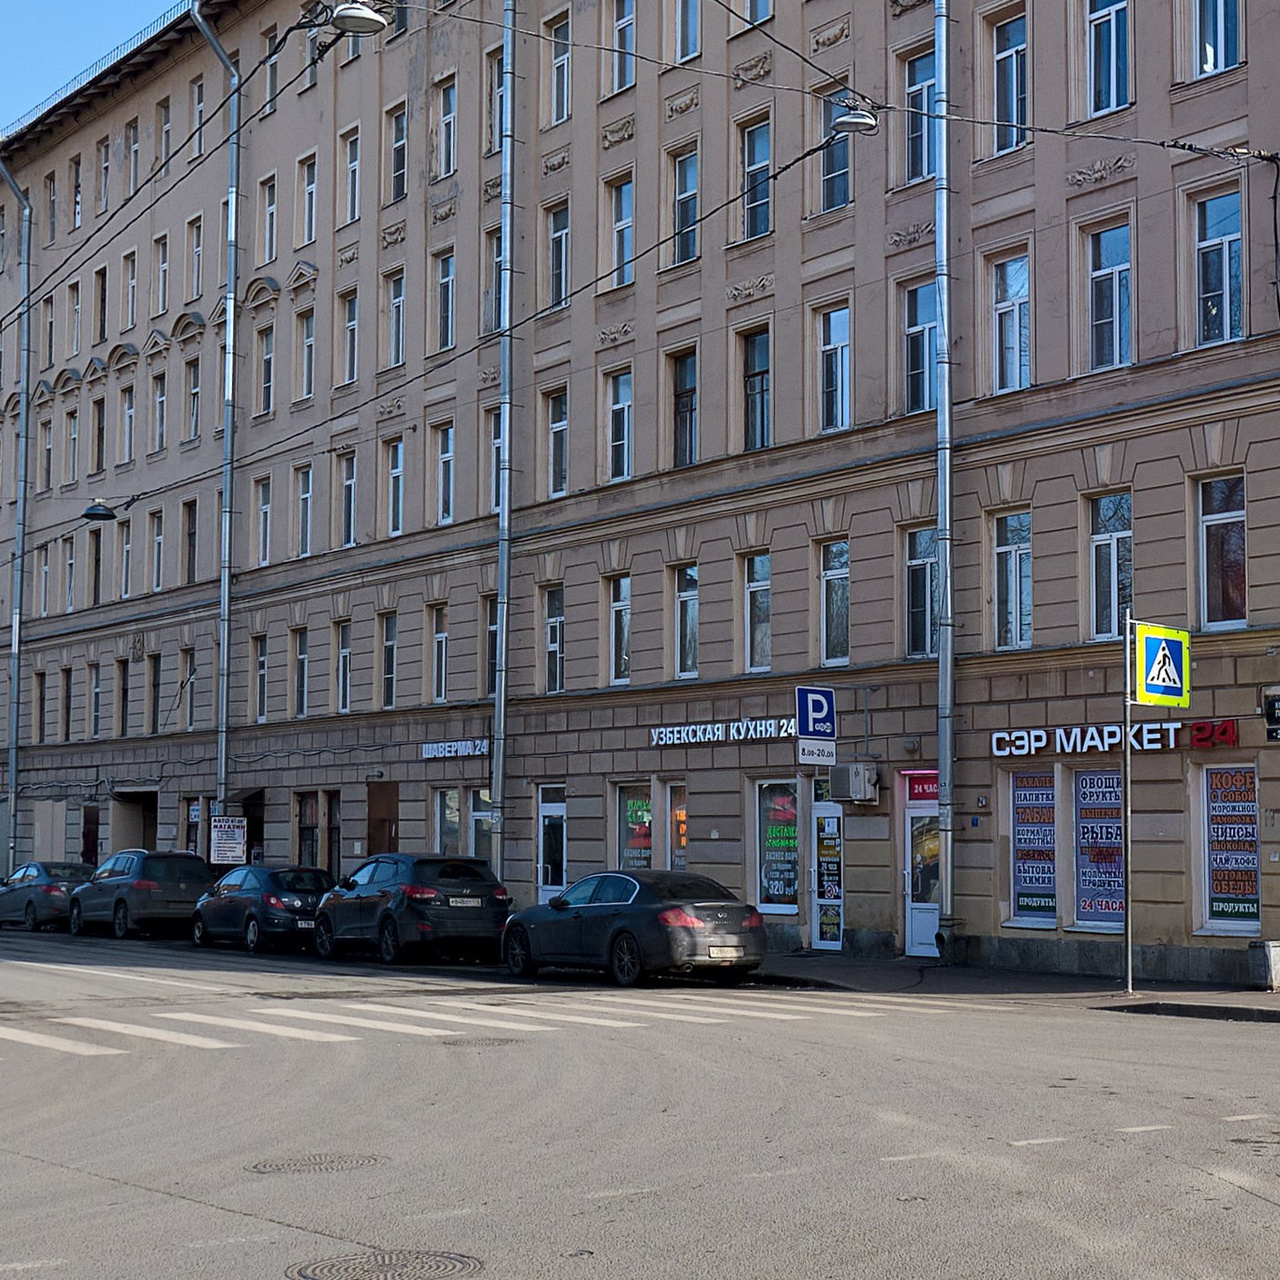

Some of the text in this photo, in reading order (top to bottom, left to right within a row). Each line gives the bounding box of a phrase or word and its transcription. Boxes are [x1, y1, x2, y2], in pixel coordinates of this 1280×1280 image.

[651, 718, 796, 745] УЗБЕКСКАЯ КУХНЯ 24
[992, 719, 1237, 756] СЭР МАРКЕТ 24
[422, 739, 488, 759] ШАВЕРМА 24
[801, 747, 834, 759] 8.00-20.00
[1211, 772, 1255, 790] КОФЕ
[914, 783, 939, 794] 24 ЧАС
[1221, 789, 1256, 803] СОБОЙ
[1211, 804, 1256, 814] МОРОЖЕНОЕ
[1211, 815, 1256, 825] ЗАМОРОЗКА
[1016, 828, 1040, 837] КОРМА
[1080, 824, 1123, 841] РЫБА
[1212, 825, 1256, 840] ЧИПСЫ
[1211, 840, 1257, 853] ШОКОЛАД
[1022, 875, 1052, 886] ХИМИЯ
[769, 881, 784, 895] 320
[1212, 880, 1258, 896] ОБЕДЫ
[1018, 897, 1056, 908] ПРОДУКТЫ
[1081, 898, 1124, 912] 24 ЧАСА
[1212, 902, 1258, 914] ПРОДУКТЫ
